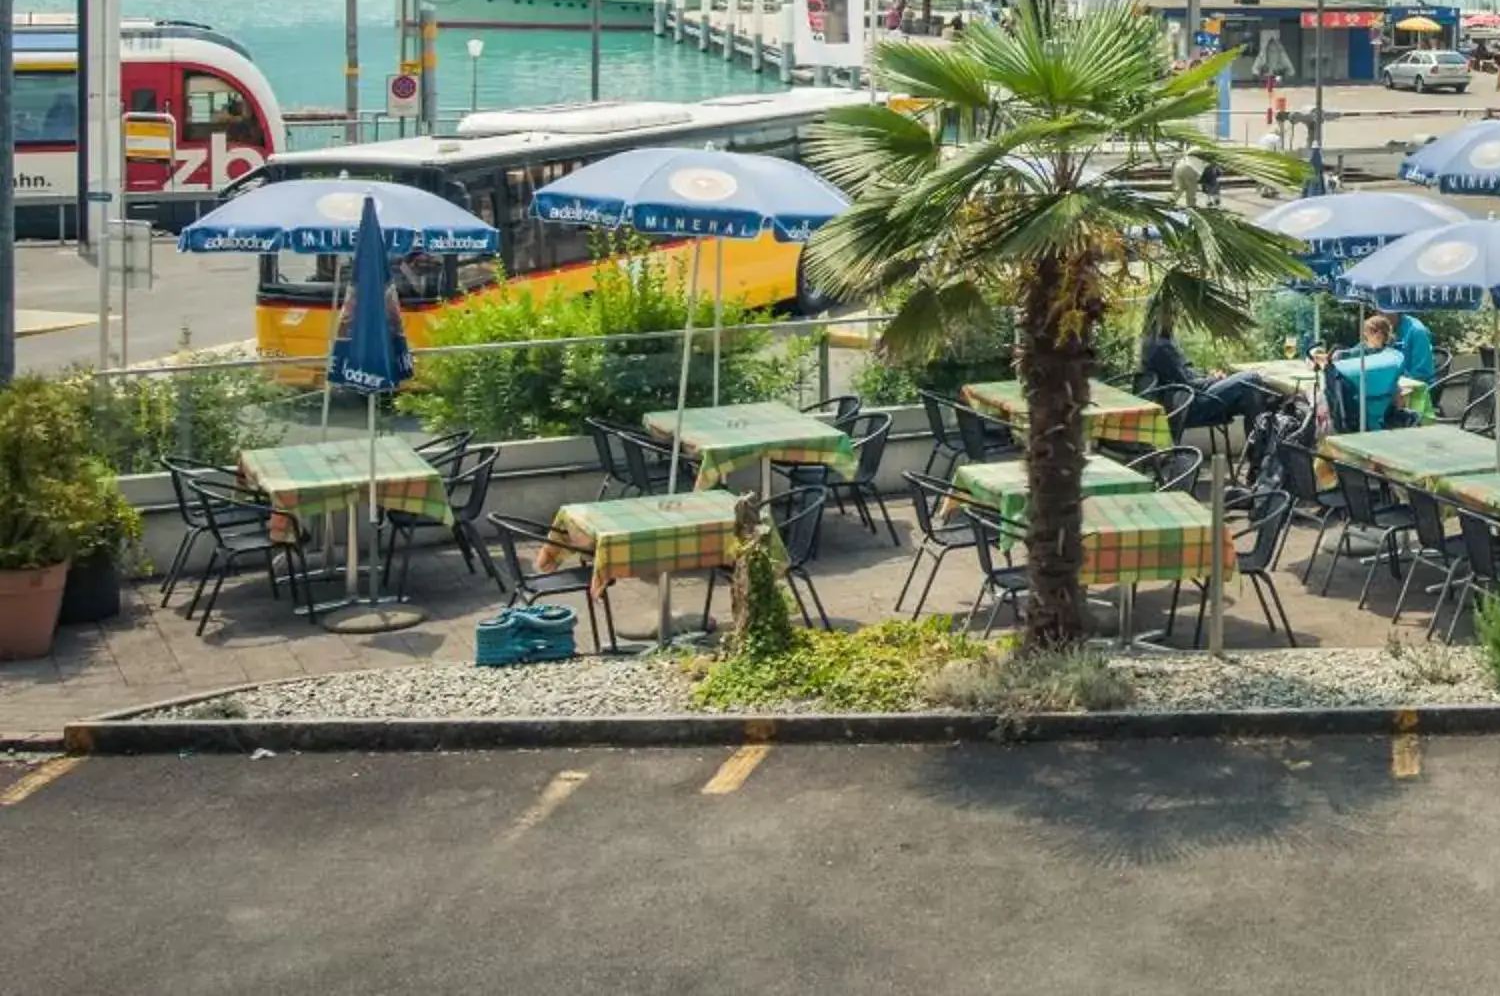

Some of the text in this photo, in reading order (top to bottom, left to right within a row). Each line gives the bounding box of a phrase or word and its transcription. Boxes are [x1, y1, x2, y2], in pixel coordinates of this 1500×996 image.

[163, 133, 267, 192] zb
[645, 217, 748, 235] MINERAL
[302, 229, 401, 247] MINEL
[1391, 285, 1477, 303] MINERAL
